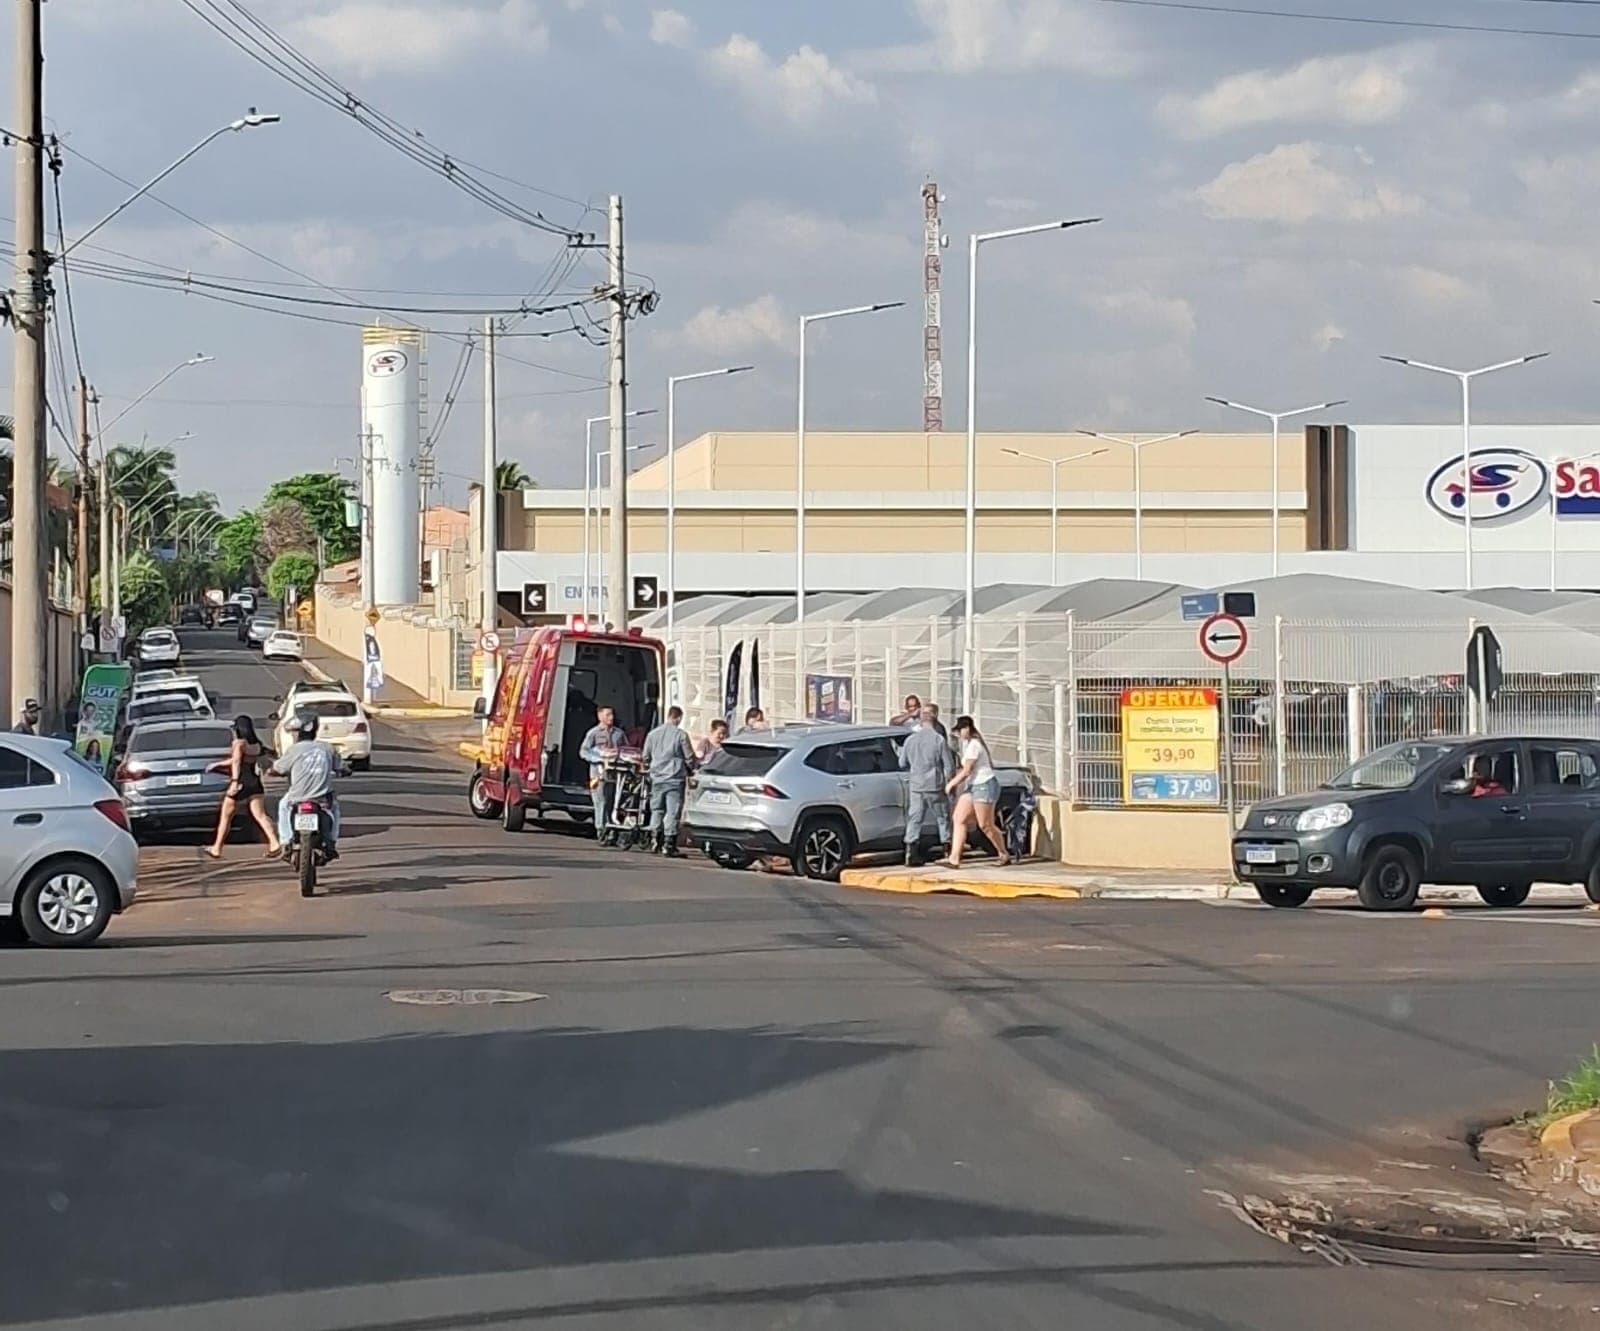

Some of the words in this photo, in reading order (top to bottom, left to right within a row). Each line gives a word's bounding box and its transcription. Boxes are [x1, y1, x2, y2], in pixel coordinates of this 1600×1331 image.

[1130, 690, 1207, 706] OFERTA
[1152, 748, 1195, 763] 39,90
[1168, 779, 1212, 799] 37,90
